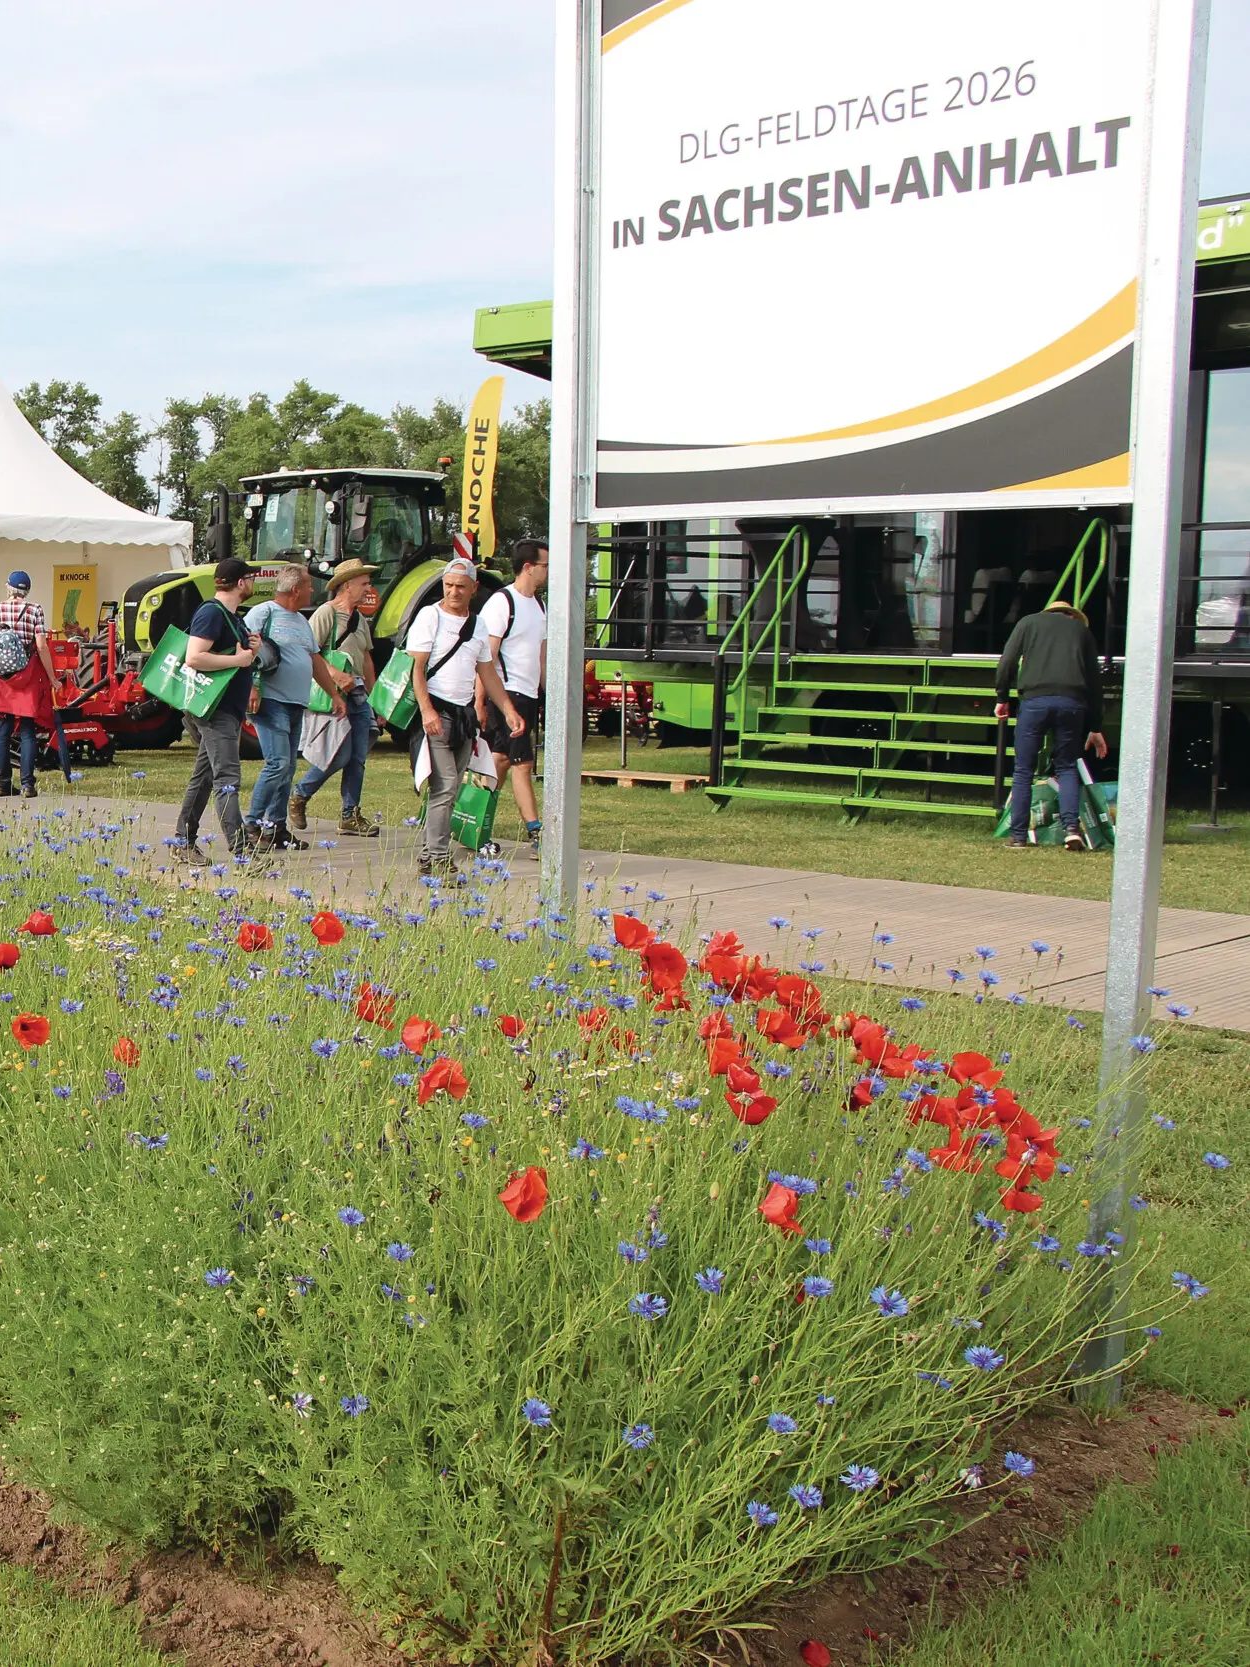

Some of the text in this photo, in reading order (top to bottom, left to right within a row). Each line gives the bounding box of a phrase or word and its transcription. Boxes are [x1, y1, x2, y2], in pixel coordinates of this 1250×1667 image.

[680, 60, 1037, 164] DLG-FELDTAGE 2026
[612, 116, 1132, 249] IN SACHSEN-ANHALT
[65, 573, 90, 581] KNOCHE
